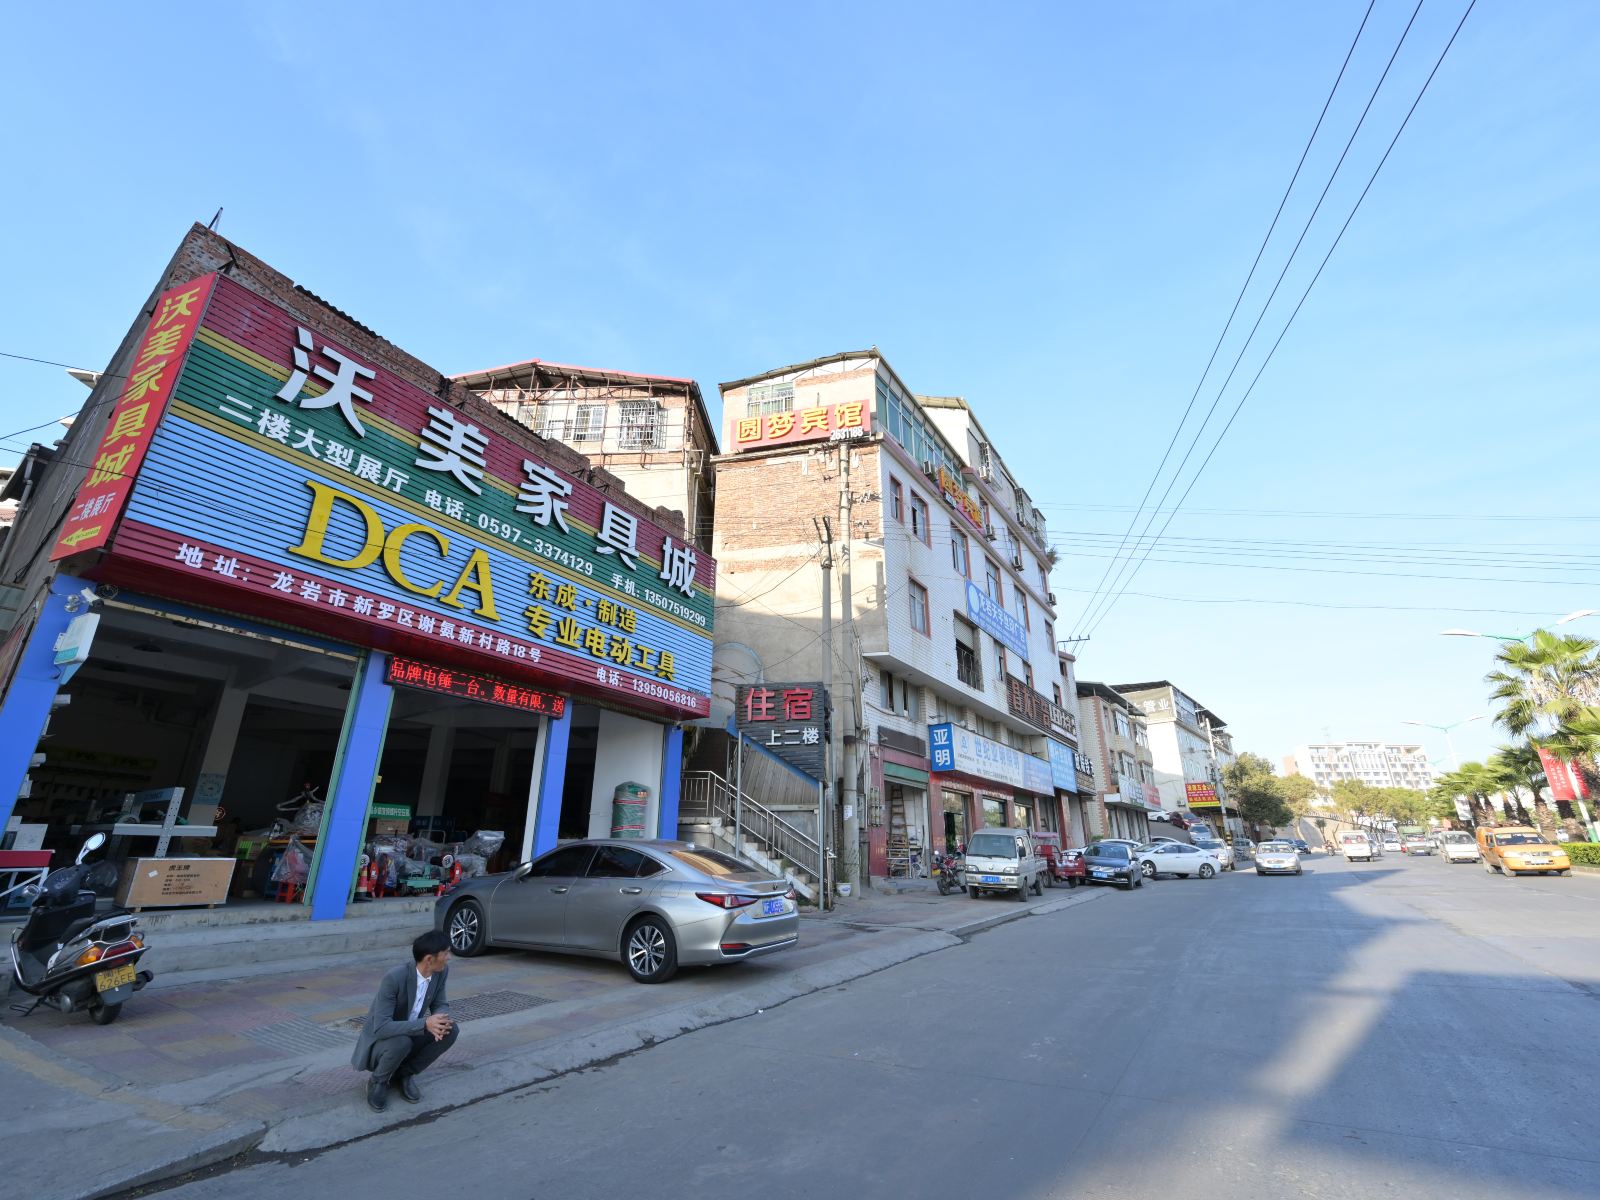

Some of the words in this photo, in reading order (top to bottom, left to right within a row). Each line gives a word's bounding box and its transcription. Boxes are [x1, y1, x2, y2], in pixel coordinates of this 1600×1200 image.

[86, 287, 200, 489] 沃美家具城
[219, 395, 410, 494] 二楼大型展厅
[736, 402, 863, 443] 圆梦宾馆
[830, 427, 863, 441] 2631188
[275, 326, 697, 599] 沃美家具城
[287, 480, 500, 621] DCA
[524, 605, 677, 681] 专业电动工具
[744, 685, 814, 722] 住宿
[765, 727, 820, 746] 上二楼
[933, 728, 951, 766] 亚明
